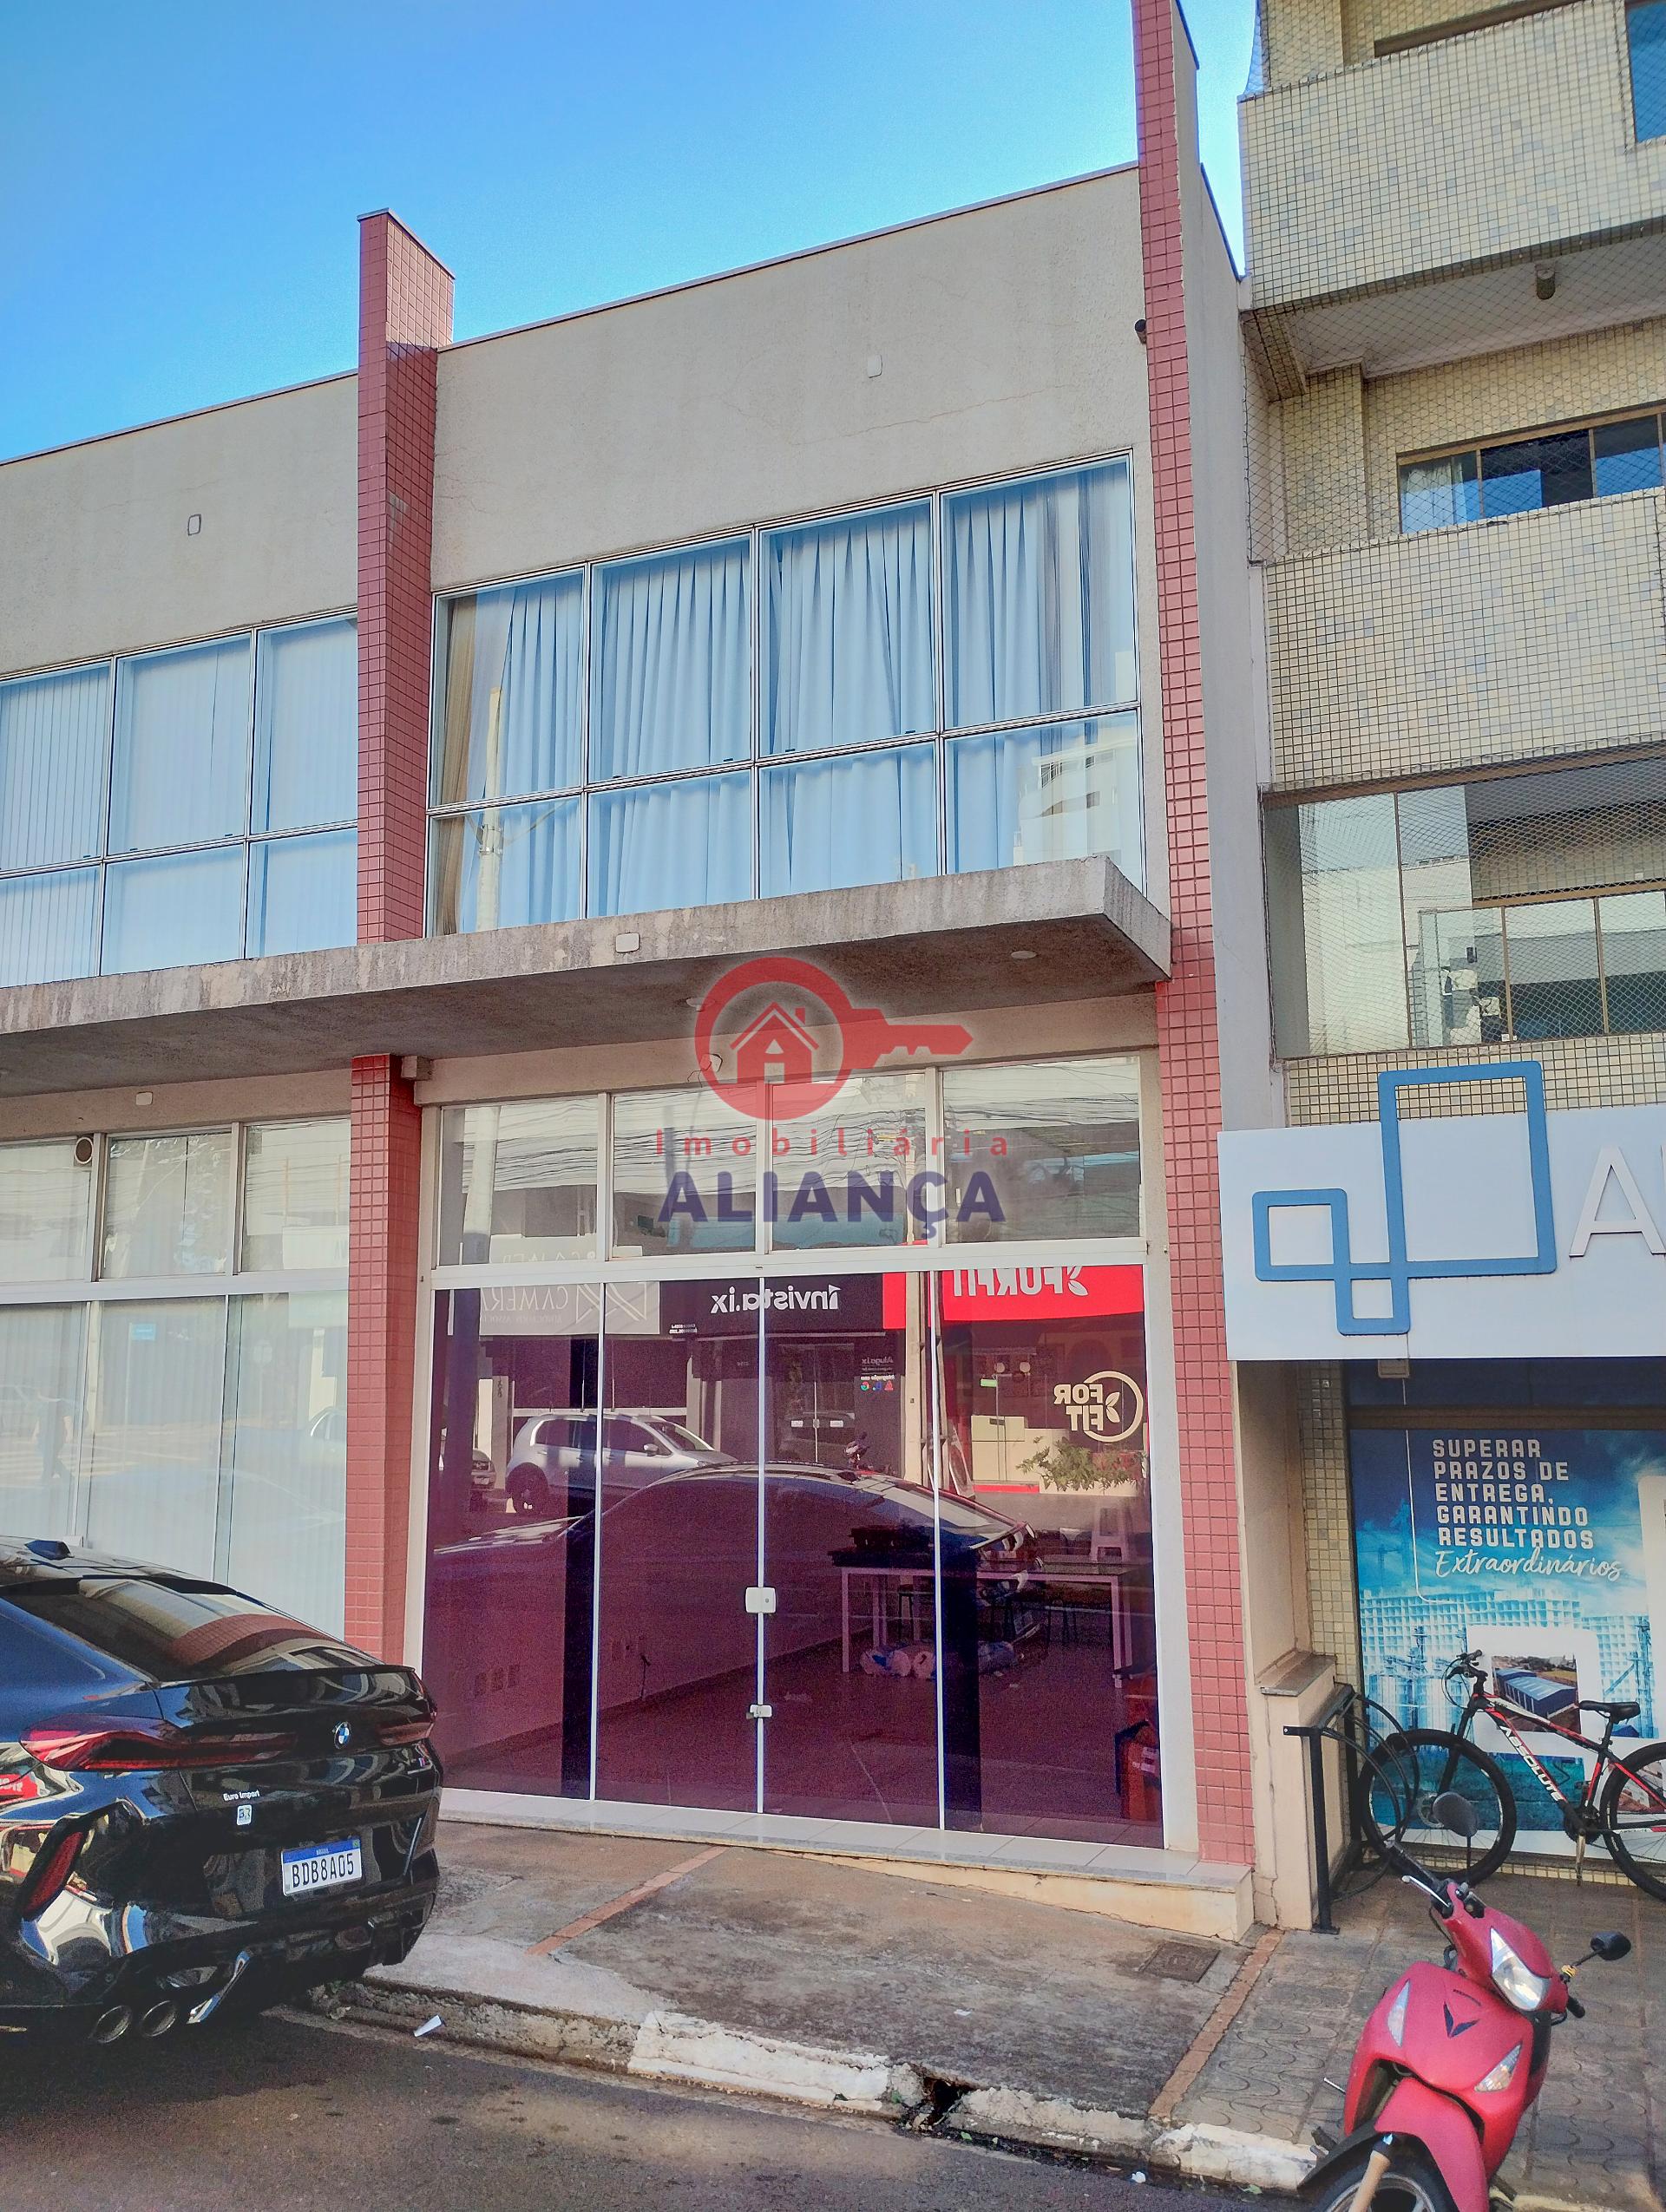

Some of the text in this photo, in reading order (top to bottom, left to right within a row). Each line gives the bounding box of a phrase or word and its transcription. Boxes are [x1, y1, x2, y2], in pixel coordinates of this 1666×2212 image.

[1569, 1146, 1666, 1258] A
[1433, 1439, 1542, 1458] SUPERAR
[1433, 1461, 1569, 1481] PRAZOS DE
[1435, 1482, 1554, 1504] ENTREGA,
[1437, 1505, 1588, 1527] GARANTINDO
[1439, 1527, 1594, 1549] RESULTADOS
[1434, 1548, 1623, 1581] Extraordinários
[292, 1853, 354, 1888] BDB8A05
